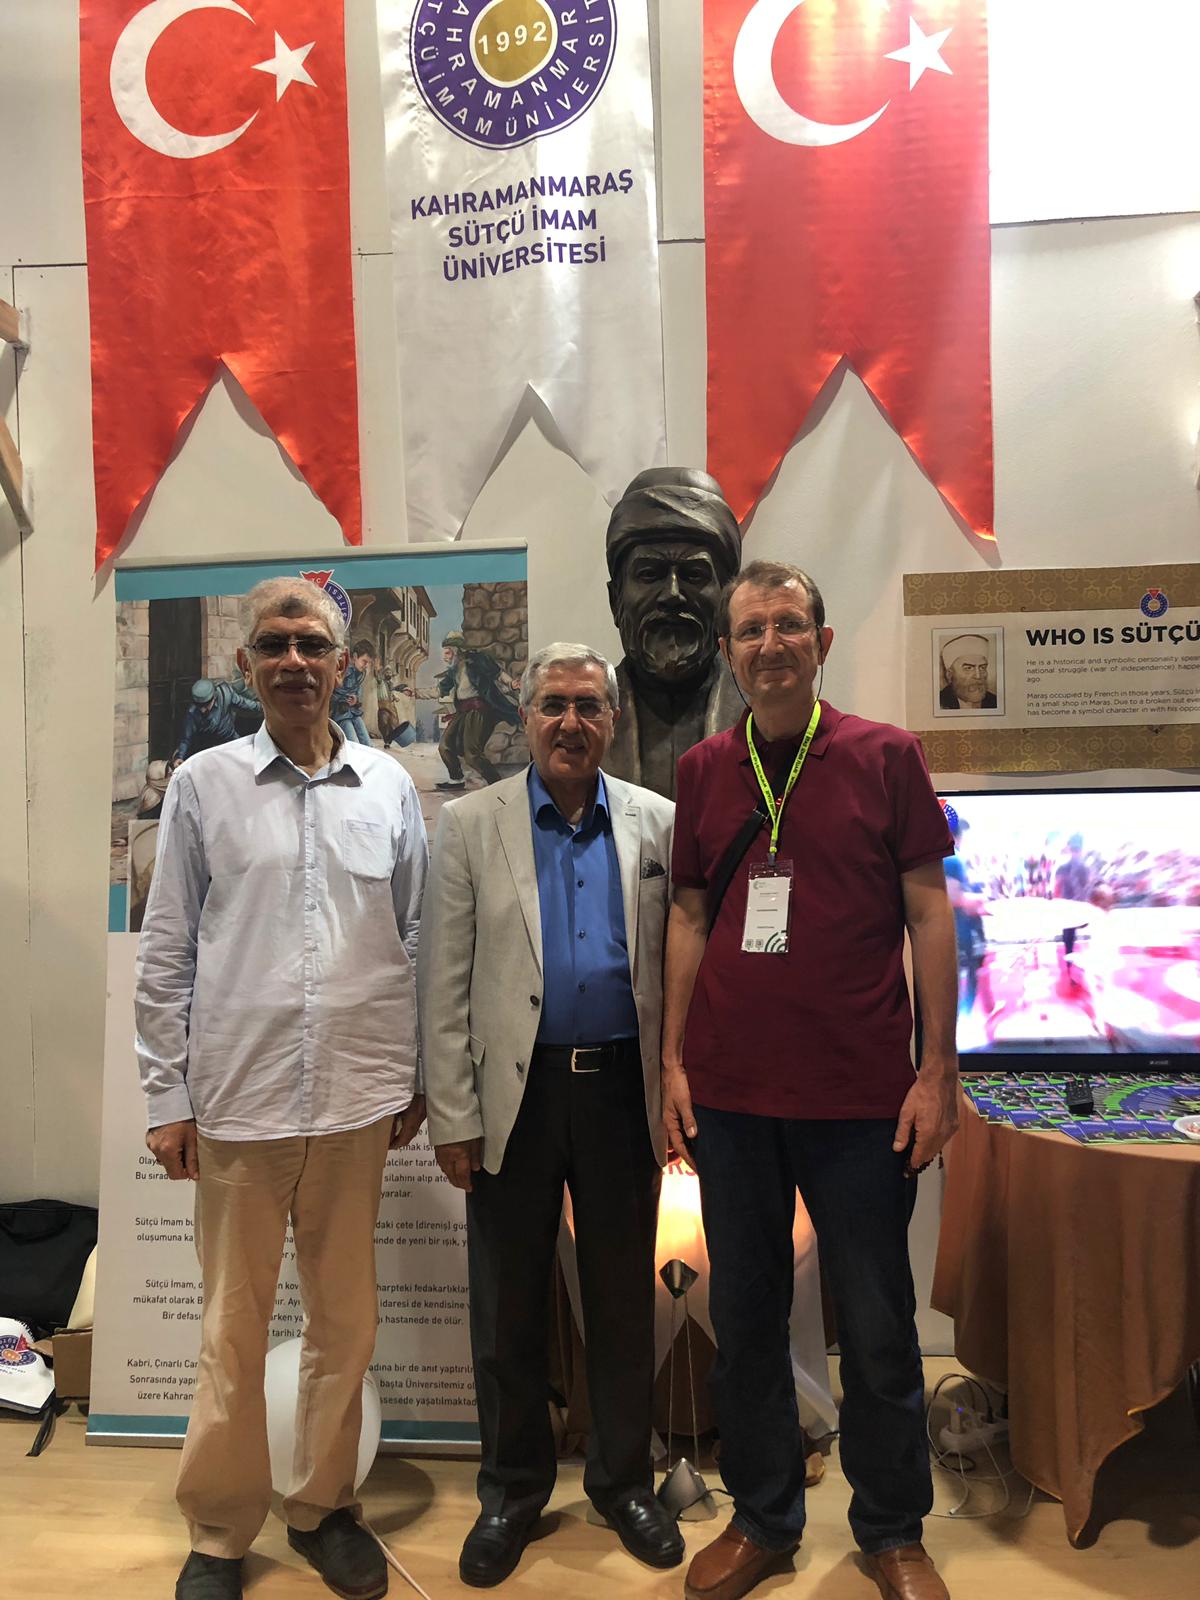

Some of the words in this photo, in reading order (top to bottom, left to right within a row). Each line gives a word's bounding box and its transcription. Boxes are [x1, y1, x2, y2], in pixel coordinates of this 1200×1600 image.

[478, 21, 547, 55] 1992
[428, 72, 493, 136] İMAM
[411, 168, 634, 220] KAHRAMANMARAŞ
[448, 209, 525, 248] SÜTÇÜ
[532, 204, 597, 231] İMAM
[443, 235, 606, 281] ÜNİVERSİTESİ
[1025, 628, 1086, 647] WHO
[1093, 627, 1114, 644] IS
[1121, 620, 1200, 645] SÜTÇÜ
[1053, 658, 1086, 666] historical
[1087, 657, 1102, 665] and
[1103, 656, 1136, 665] symbolic
[1137, 655, 1179, 664] personality
[1026, 667, 1055, 675] national
[1058, 666, 1088, 675] struggle
[1049, 691, 1082, 701] occupied
[1083, 690, 1093, 699] by
[1094, 690, 1119, 698] French
[1120, 689, 1127, 697] in
[1128, 688, 1149, 697] those
[1062, 699, 1080, 708] shop
[1113, 697, 1129, 705] Due
[1130, 697, 1137, 705] to
[1146, 696, 1172, 705] broken
[1172, 696, 1185, 704] out
[1041, 708, 1071, 716] become
[1078, 706, 1104, 716] symbol
[1105, 705, 1140, 715] character
[1150, 705, 1167, 713] with
[135, 1171, 147, 1180] Bu
[419, 1174, 434, 1184] alıp
[135, 1217, 159, 1228] Sütçü
[160, 1216, 184, 1226] İmam
[136, 1232, 182, 1243] oluşumuna
[396, 1235, 407, 1245] de
[408, 1235, 427, 1247] yeni
[428, 1235, 441, 1245] bir
[145, 1278, 169, 1290] Sütçü
[170, 1278, 196, 1289] İmam,
[132, 1295, 168, 1305] mükafat
[169, 1295, 195, 1305] olarak
[380, 1299, 409, 1309] idaresi
[411, 1300, 421, 1309] de
[424, 1299, 465, 1310] kendisine
[162, 1310, 175, 1321] Bir
[385, 1315, 427, 1325] hastanede
[431, 1316, 442, 1326] de
[272, 1329, 295, 1338] tarihi
[127, 1358, 153, 1369] Kabri,
[154, 1358, 182, 1370] Çınarlı
[368, 1362, 393, 1373] adına
[394, 1363, 407, 1373] bir
[408, 1363, 420, 1373] de
[421, 1363, 438, 1374] anıt
[130, 1374, 177, 1386] Sonrasında
[380, 1379, 404, 1391] başta
[405, 1377, 465, 1391] Üniversitemiz
[137, 1390, 161, 1401] üzere
